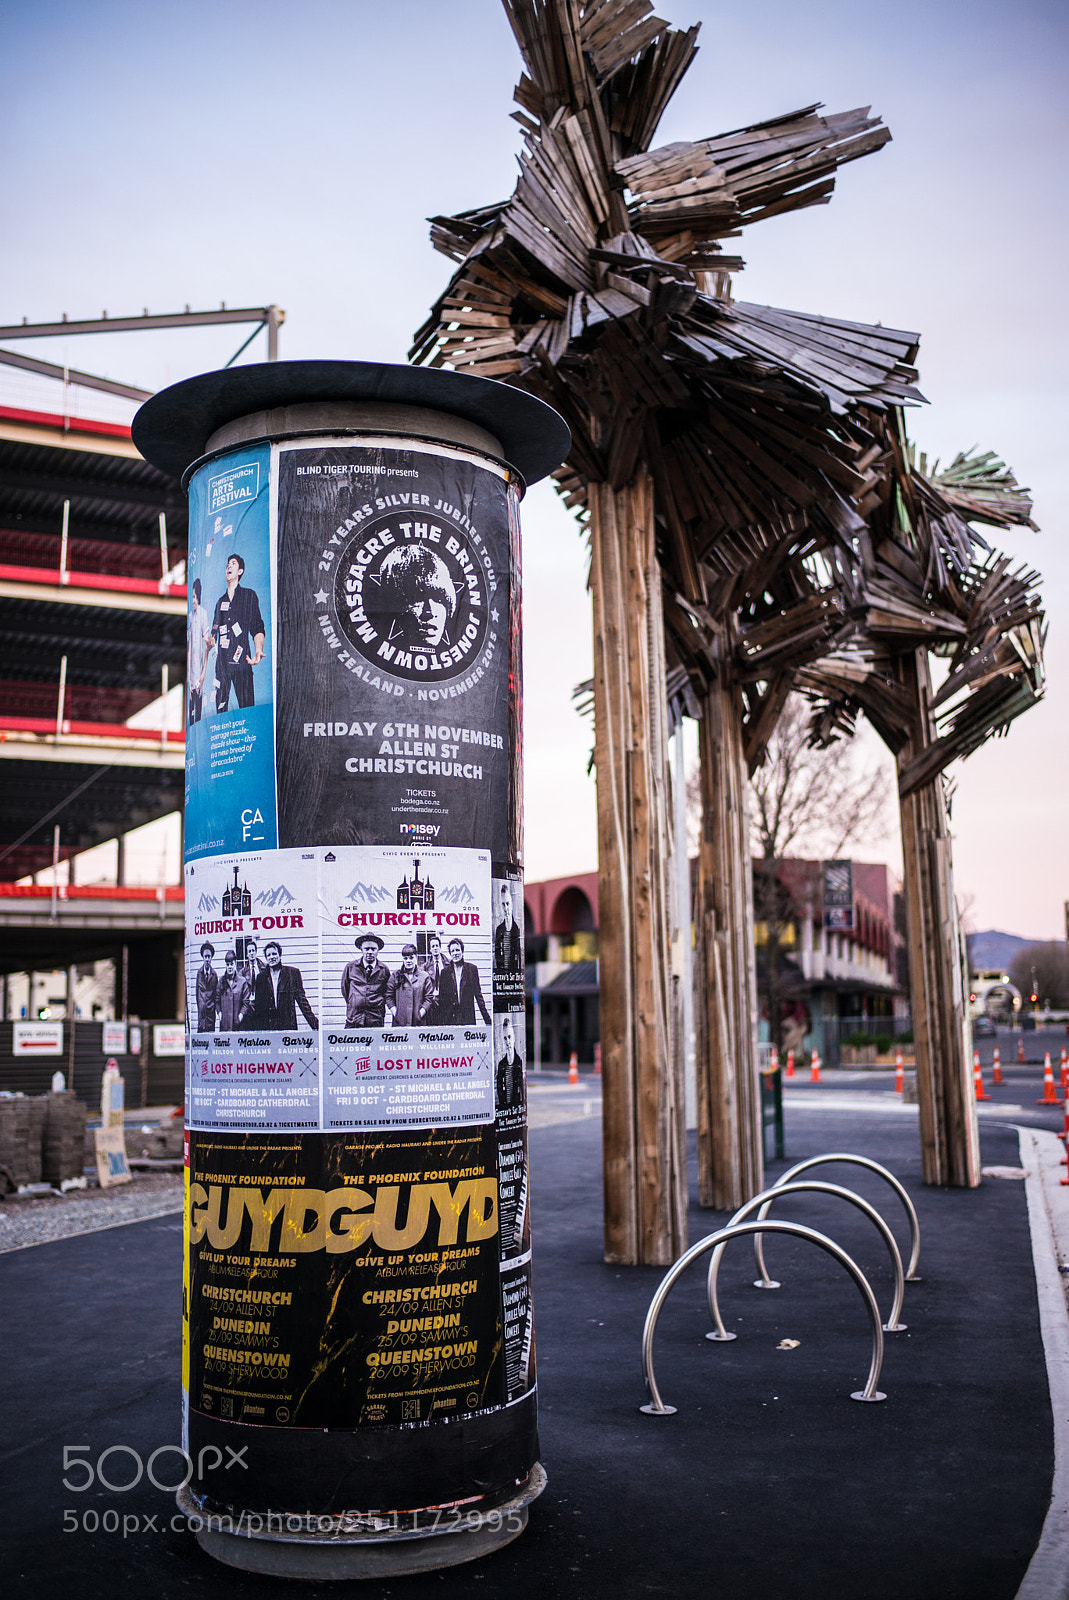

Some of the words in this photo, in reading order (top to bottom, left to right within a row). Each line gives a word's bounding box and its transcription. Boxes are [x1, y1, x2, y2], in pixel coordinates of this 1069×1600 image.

[212, 469, 254, 487] CHRISTCHURCH
[296, 466, 322, 476] BLIND
[323, 465, 348, 474] TIGER
[349, 465, 387, 474] TOURING
[387, 468, 419, 478] presents
[212, 482, 234, 498] ARTS
[212, 487, 252, 508] FESTIVAL
[399, 522, 442, 543] THE
[318, 550, 335, 572] 25
[328, 503, 374, 546] YEARS
[375, 493, 430, 510] SILVER
[434, 499, 482, 546] JUBILEE
[480, 545, 498, 592] TOUR
[445, 536, 481, 606] BRIAN
[346, 528, 396, 644] MASSACRE
[376, 612, 482, 672] JONESTOWN
[318, 614, 342, 649] NEW
[337, 649, 405, 696] ZEALAND
[417, 666, 485, 701] NOVEMBER
[481, 631, 497, 669] 2015
[232, 720, 246, 729] your
[226, 738, 240, 746] show
[244, 734, 257, 743] this
[303, 722, 378, 737] FRIDAY
[382, 723, 420, 738] 6TH
[425, 725, 504, 749] NOVEMBER
[246, 743, 253, 753] of
[378, 740, 436, 757] ALLEN
[440, 744, 459, 759] ST
[345, 757, 483, 780] CHRISTCHURCH
[400, 798, 441, 806] bodega.co.nz
[406, 789, 437, 798] TICKETS
[241, 808, 264, 825] CA
[400, 824, 441, 837] noisey
[194, 918, 244, 935] CHURCH
[249, 915, 304, 931] TOUR
[337, 912, 427, 927] CHURCH
[432, 913, 481, 926] TOUR
[213, 1037, 231, 1047] Tami
[237, 1037, 271, 1048] Marlon
[282, 1036, 314, 1048] Barry
[327, 1034, 374, 1047] Delaney
[381, 1033, 409, 1043] Tami
[418, 1032, 455, 1042] Marlon
[463, 1031, 487, 1042] Barry
[277, 1047, 319, 1055] SAUNDERS
[211, 1063, 233, 1074] LOST
[236, 1062, 295, 1075] HIGHWAY
[355, 1058, 371, 1073] THE
[376, 1059, 413, 1071] LOST
[416, 1056, 474, 1070] HIGHWAY
[221, 1088, 229, 1096] ST
[229, 1088, 260, 1097] MICHAEL
[261, 1088, 268, 1097] &
[269, 1088, 284, 1096] ALL
[286, 1087, 319, 1097] ANGELS
[328, 1086, 360, 1095] THURS
[359, 1086, 367, 1094] 8
[367, 1085, 385, 1094] OCT
[395, 1085, 406, 1093] ST
[408, 1083, 444, 1093] MICHAEL
[445, 1083, 453, 1091] &
[453, 1082, 467, 1090] ALL
[467, 1080, 491, 1090] ANGELS
[217, 1098, 257, 1107] CARDBOARD
[257, 1098, 311, 1107] CATHERDRAL
[336, 1097, 351, 1106] FRI
[353, 1097, 361, 1105] 9
[361, 1096, 379, 1105] OCT
[388, 1094, 441, 1104] CARDBOARD
[441, 1090, 486, 1101] CATHERDRAL
[215, 1109, 266, 1118] CHRISTCHURCH
[386, 1104, 451, 1115] CHRISTCHURCH
[461, 1112, 491, 1120] TICKETMASTER
[194, 1172, 204, 1181] THE
[205, 1174, 238, 1184] PHOENIX
[239, 1175, 306, 1185] FOUNDATION
[343, 1175, 365, 1185] THE
[368, 1172, 421, 1184] PHOENIX
[424, 1166, 485, 1180] FOUNDATION
[199, 1251, 213, 1262] GIVE
[213, 1254, 224, 1263] UP
[227, 1255, 251, 1266] YOUR
[253, 1257, 297, 1268] DREAMS
[355, 1256, 384, 1267] GIVE
[388, 1255, 404, 1265] UP
[408, 1252, 439, 1263] YOUR
[442, 1246, 481, 1261] DREAMS
[202, 1284, 292, 1305] CHRISTCHURCH
[362, 1280, 478, 1305] CHRISTCHURCH
[235, 1303, 263, 1316] ALLEN
[265, 1305, 278, 1317] ST
[379, 1301, 419, 1317] 24/09
[421, 1297, 452, 1313] ALLEN
[455, 1295, 466, 1308] ST
[213, 1316, 271, 1335] DUNEDIN
[387, 1313, 461, 1334] DUNEDIN
[234, 1333, 279, 1348] SAMMY'S
[378, 1332, 417, 1348] 25/09
[420, 1325, 469, 1343] SAMMY'S
[203, 1344, 291, 1367] QUEENSTOWN
[366, 1340, 478, 1367] QUEENSTOWN
[228, 1363, 288, 1379] SHERWOOD
[369, 1364, 410, 1379] 26/09
[412, 1354, 476, 1375] SHERWOOD
